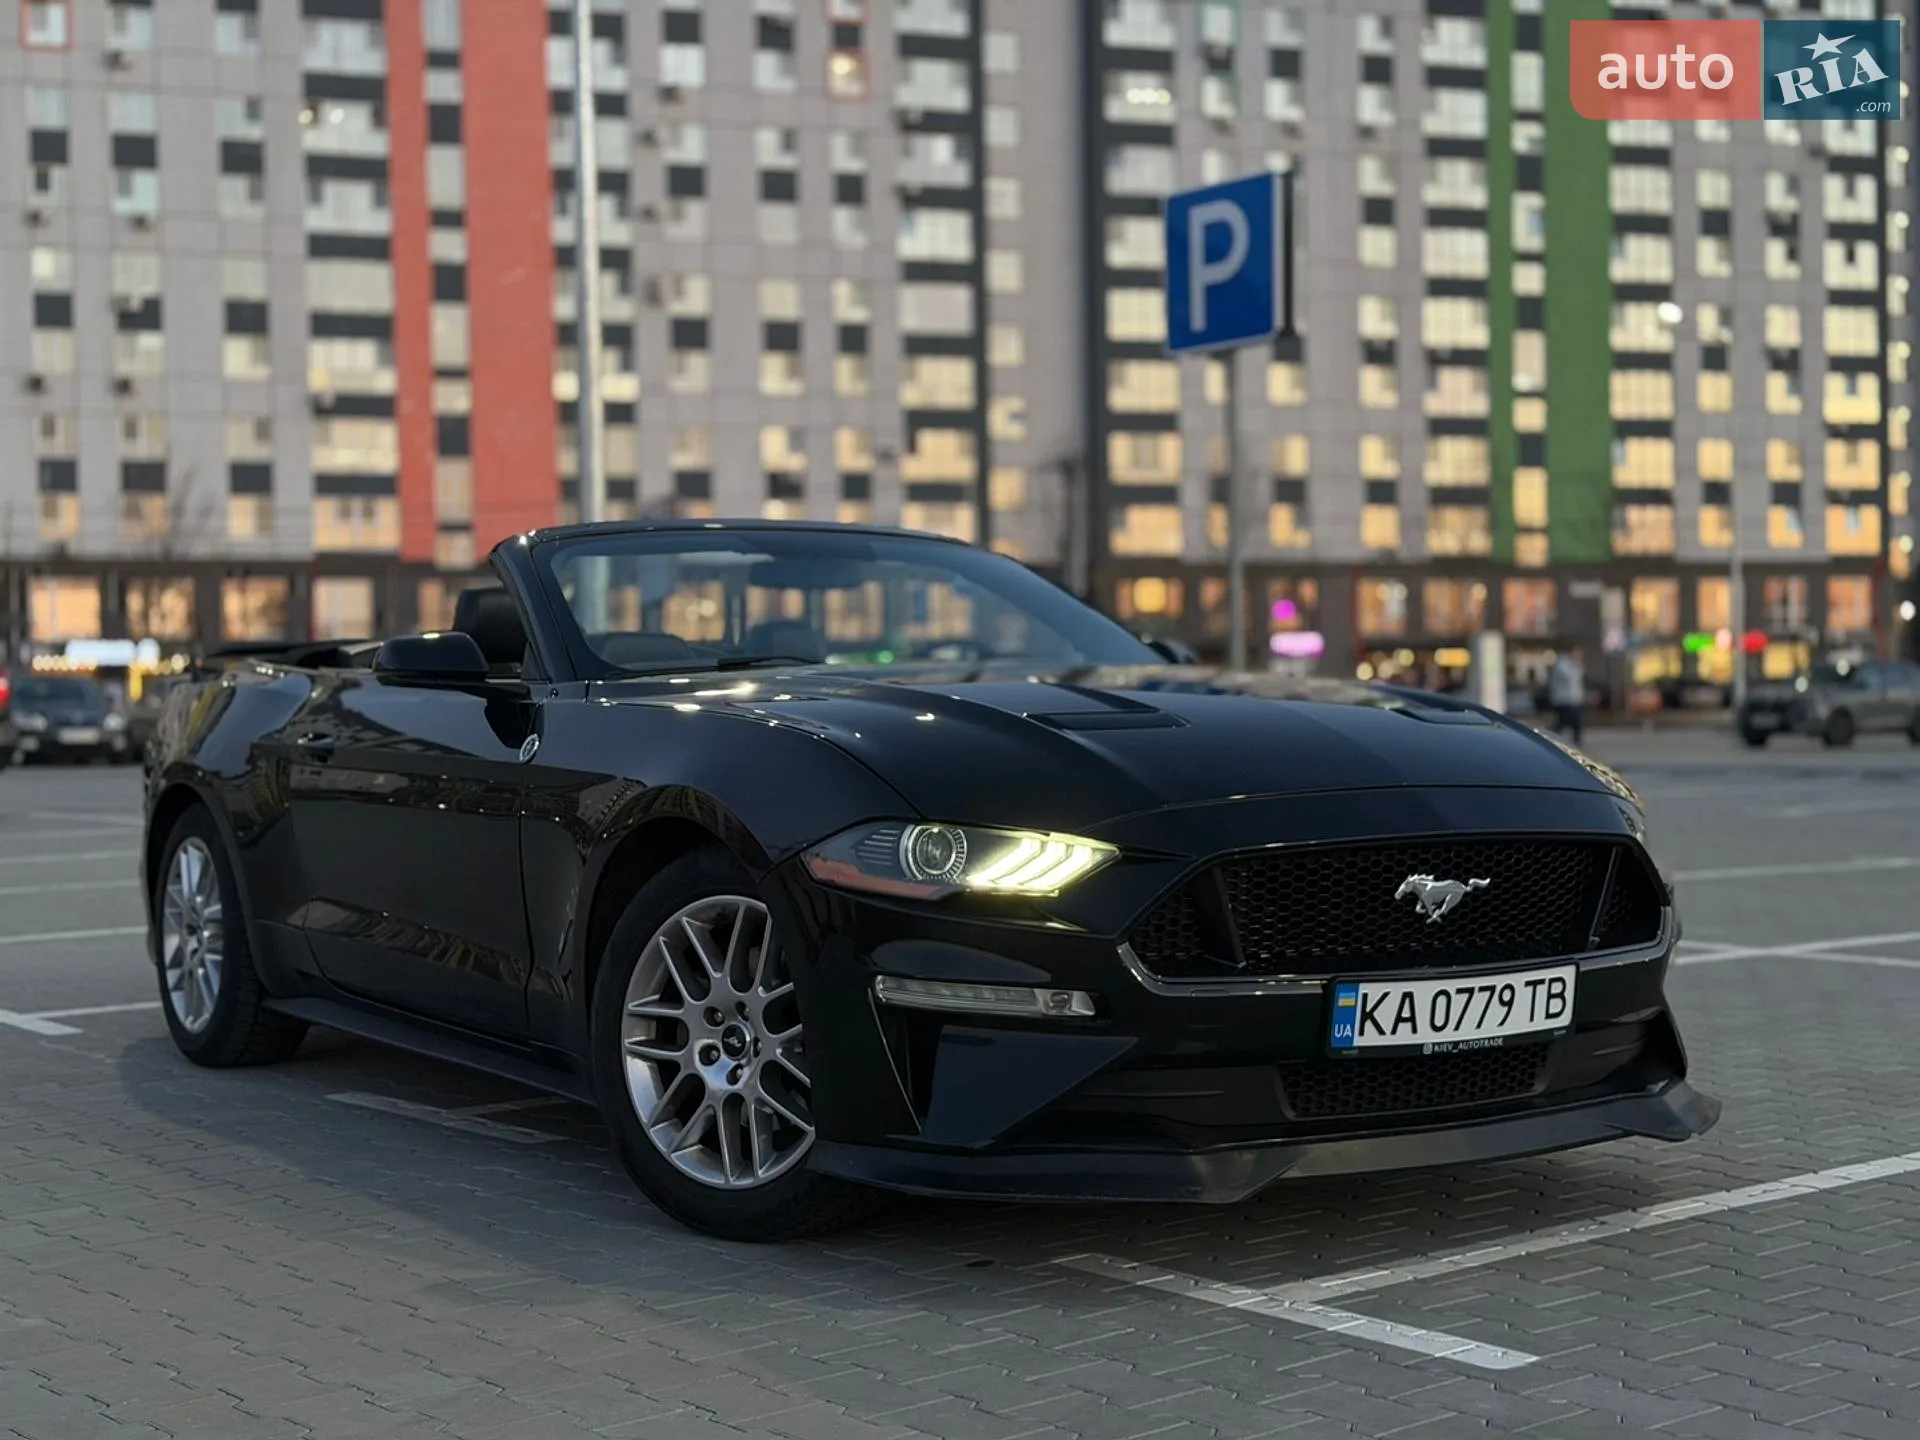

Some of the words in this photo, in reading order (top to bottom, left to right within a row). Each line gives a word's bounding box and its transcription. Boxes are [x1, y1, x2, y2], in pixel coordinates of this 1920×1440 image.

[1188, 198, 1250, 333] P
[1334, 1023, 1352, 1038] UA
[1358, 991, 1418, 1036] KA
[1429, 983, 1515, 1033] 0779
[1524, 976, 1567, 1022] TB
